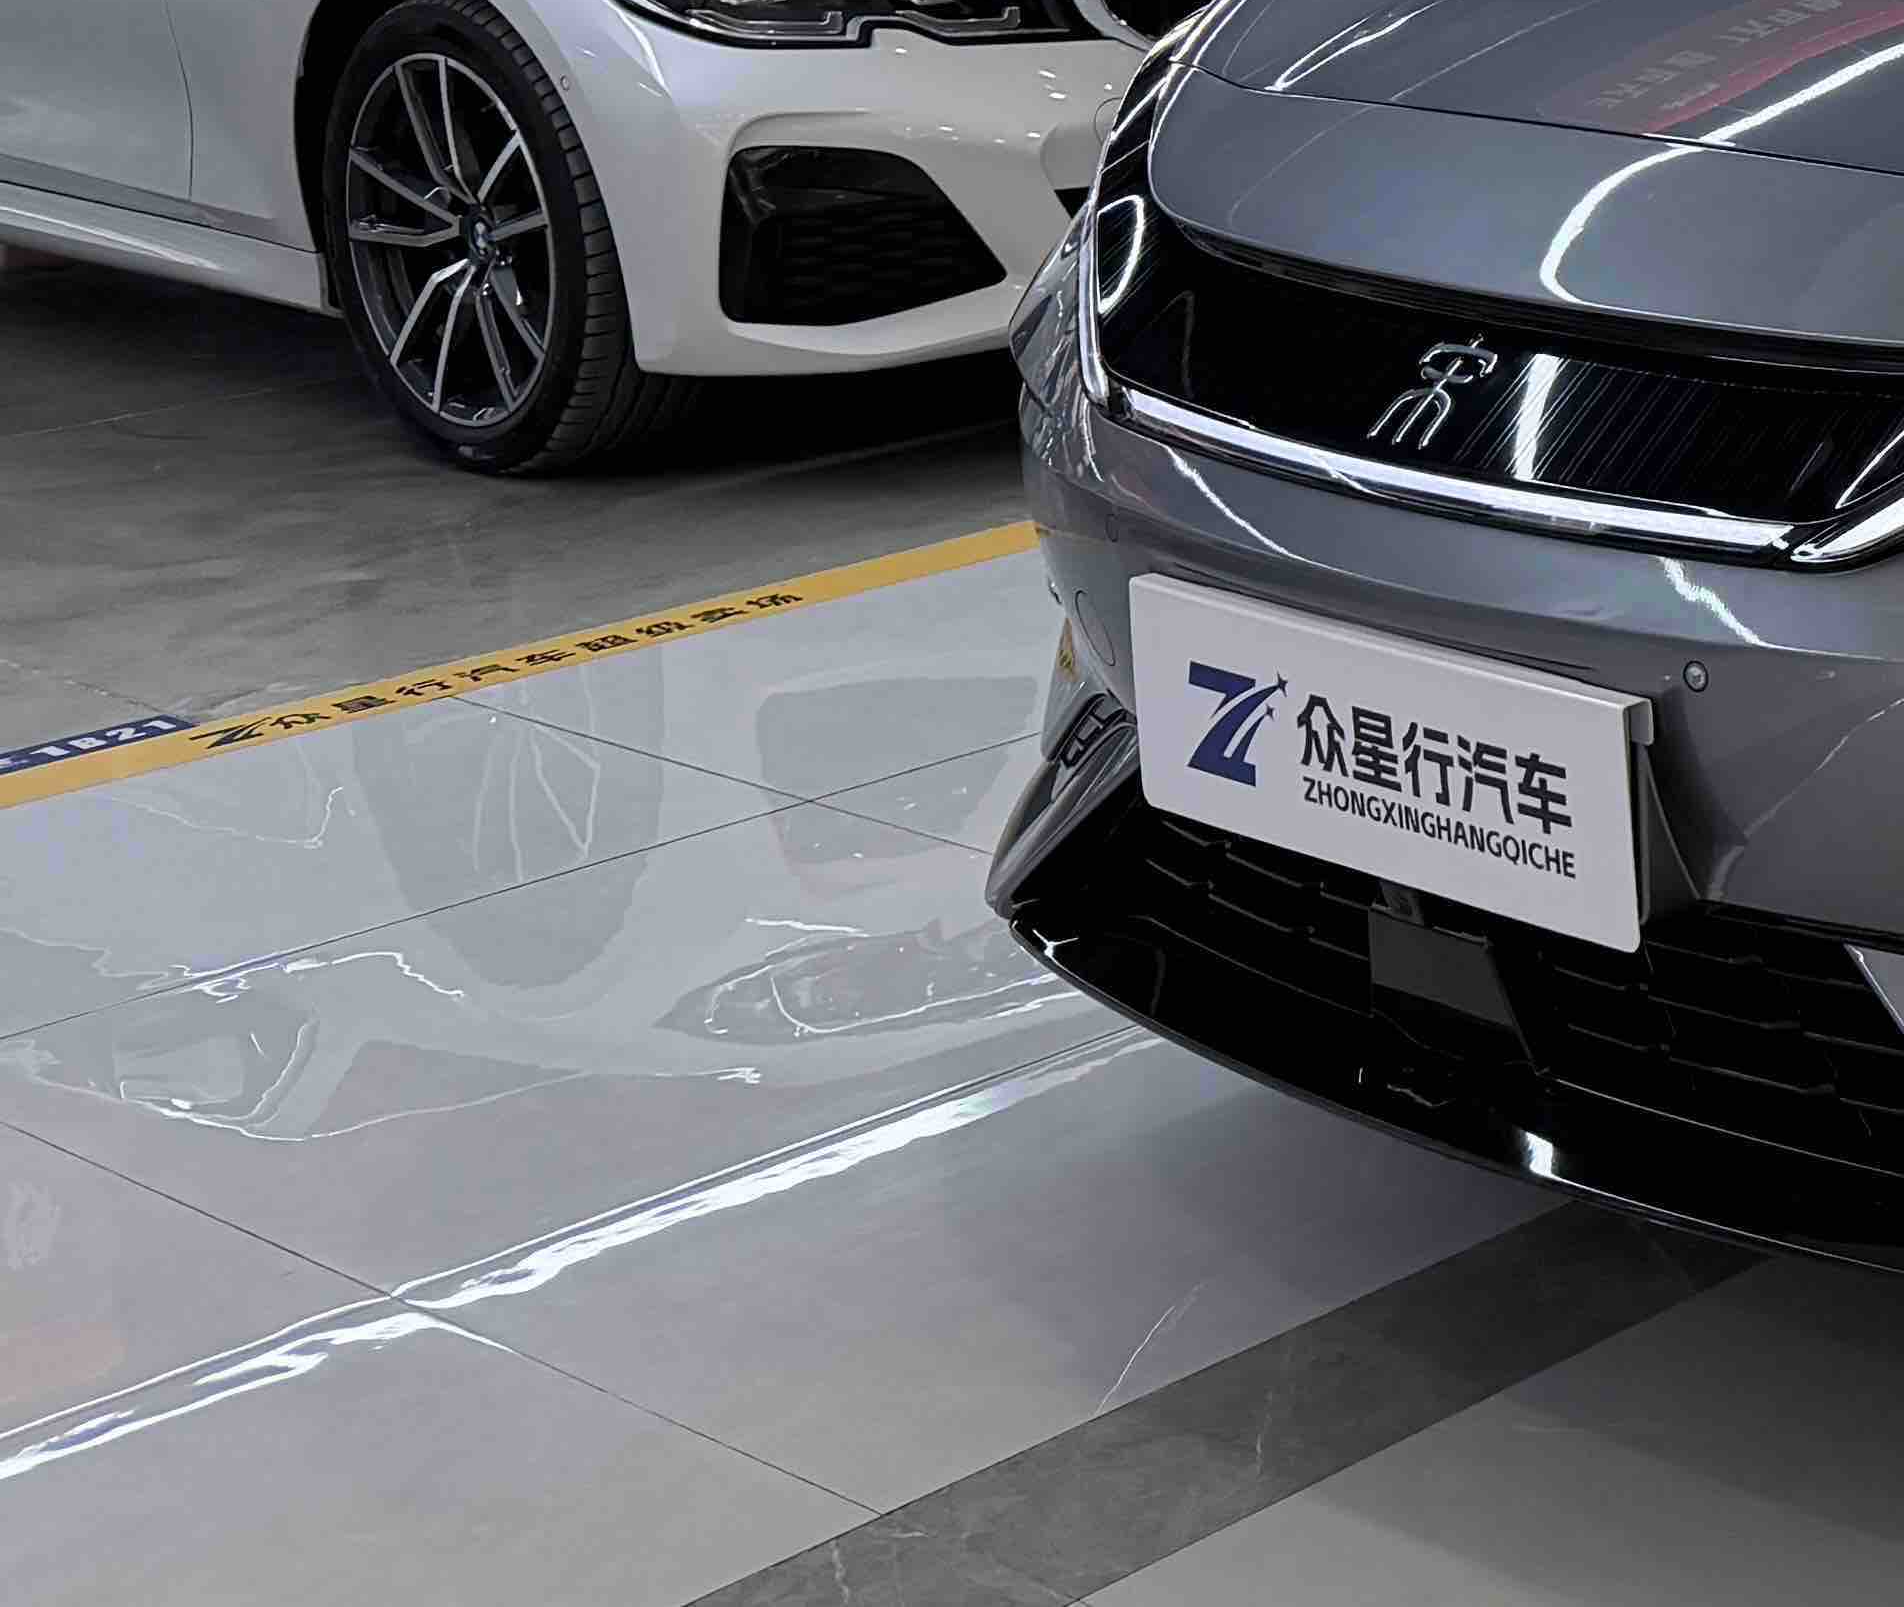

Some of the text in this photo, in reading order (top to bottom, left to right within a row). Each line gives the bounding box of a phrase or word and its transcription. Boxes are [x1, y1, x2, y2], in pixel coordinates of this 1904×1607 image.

[1296, 693, 1573, 835] 众星行汽车
[1303, 776, 1576, 879] ZHONGXINGHANGQICHE
